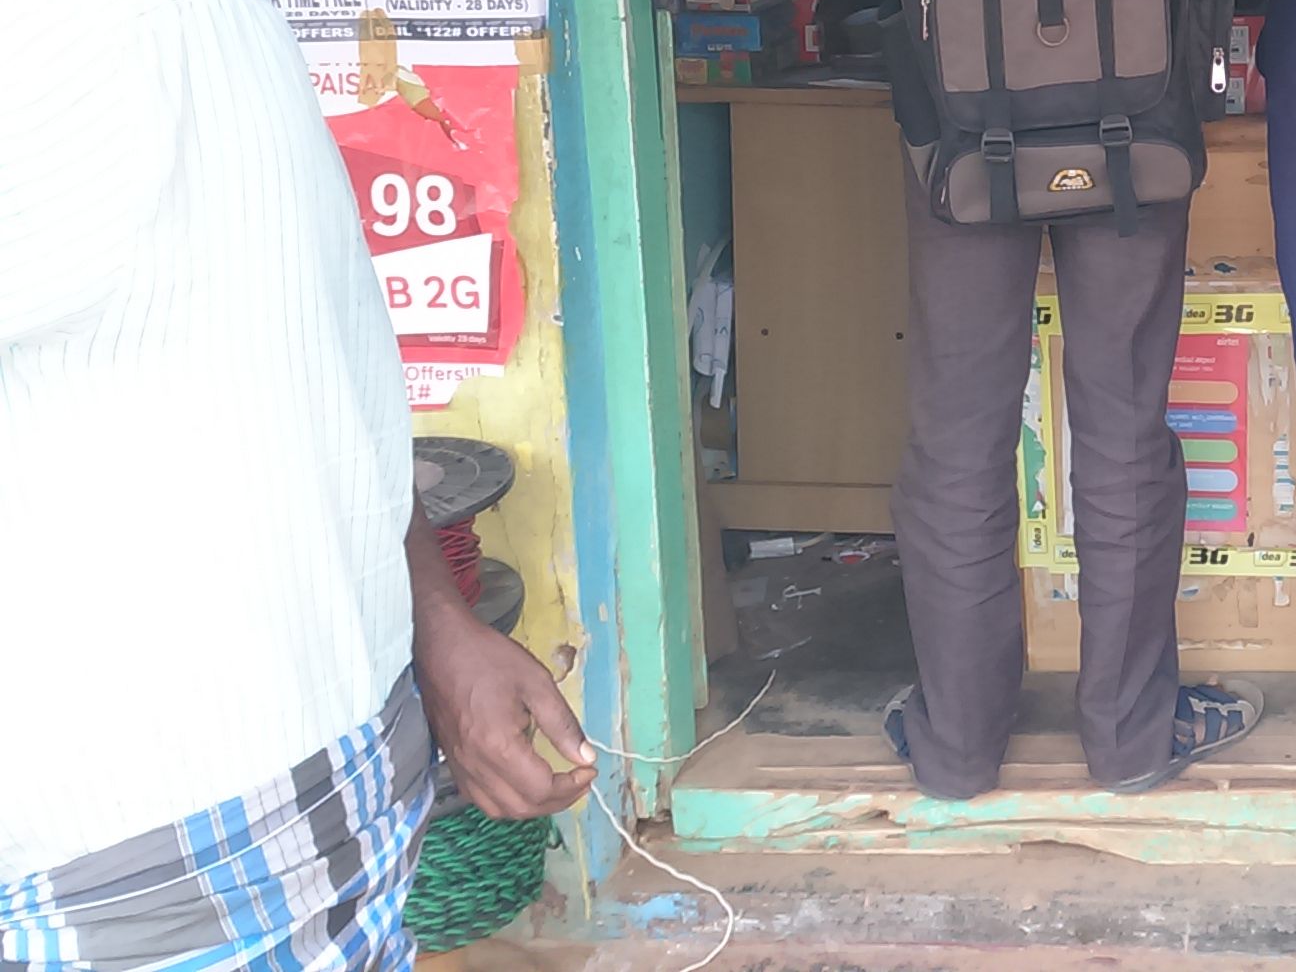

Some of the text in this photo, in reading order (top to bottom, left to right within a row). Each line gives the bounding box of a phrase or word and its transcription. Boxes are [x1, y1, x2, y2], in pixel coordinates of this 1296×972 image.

[385, 0, 452, 13] (VALIDITY
[465, 0, 482, 11] 28
[487, 0, 529, 12] DAYS)
[466, 26, 533, 37] OFFERS
[370, 173, 457, 237] 98
[424, 275, 480, 309] 2G
[1214, 304, 1254, 323] 3G
[1189, 547, 1229, 565] 3G
